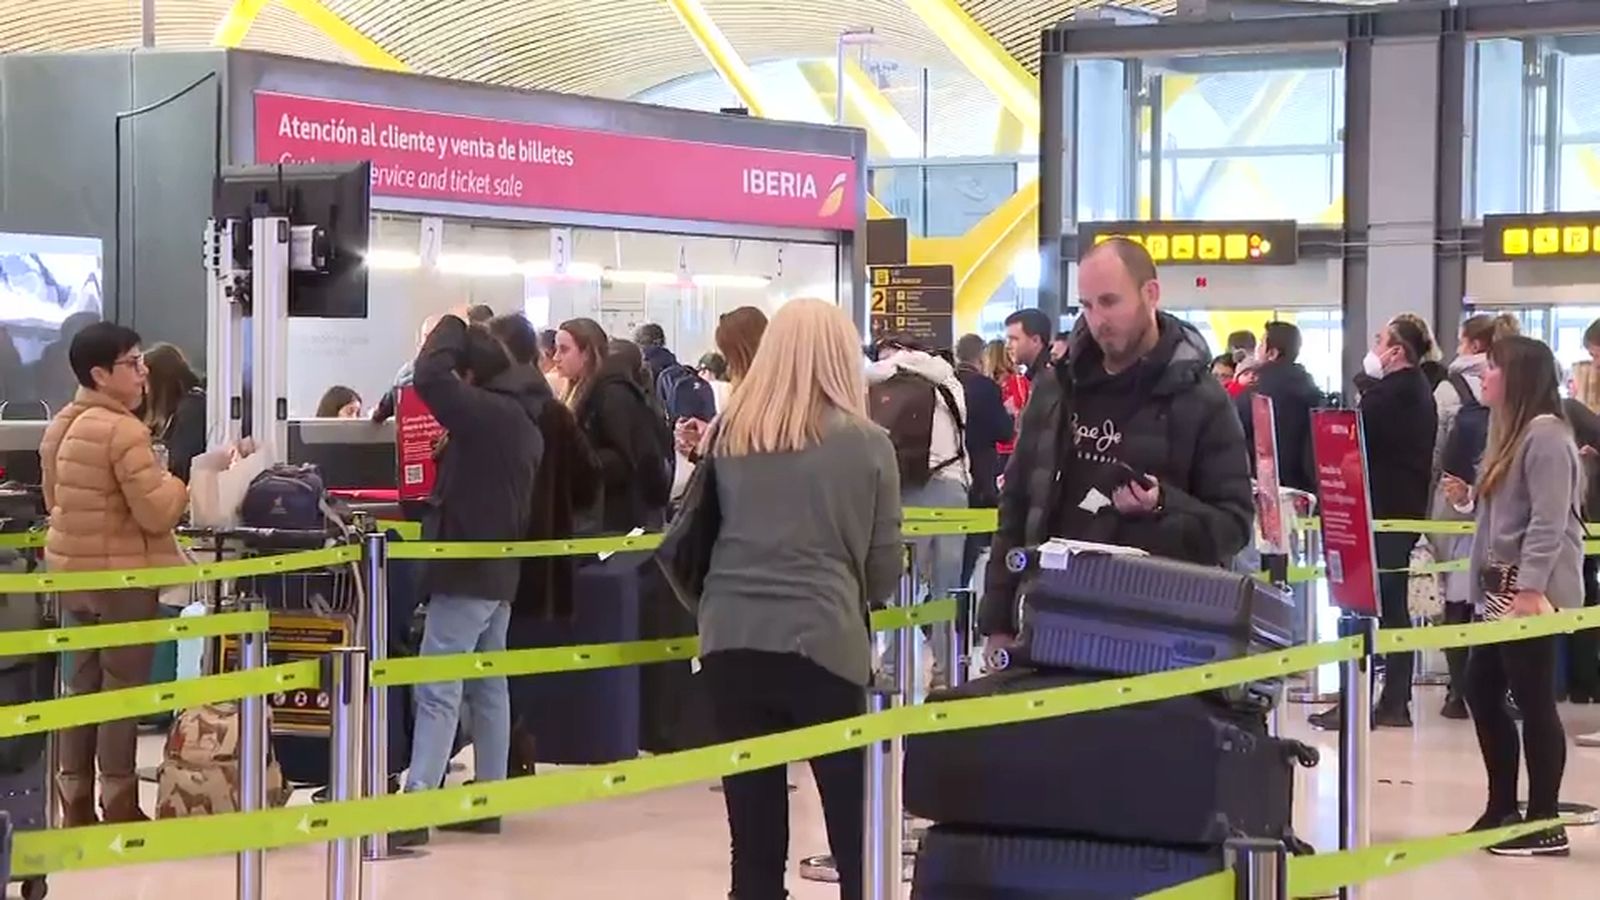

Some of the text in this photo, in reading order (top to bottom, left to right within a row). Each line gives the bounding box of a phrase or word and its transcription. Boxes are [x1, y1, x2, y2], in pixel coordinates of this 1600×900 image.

[278, 113, 575, 167] Atención al cliente y venta de billetes
[369, 167, 523, 197] ervice and ticket sale
[743, 169, 818, 199] IBERIA
[871, 289, 884, 312] 2
